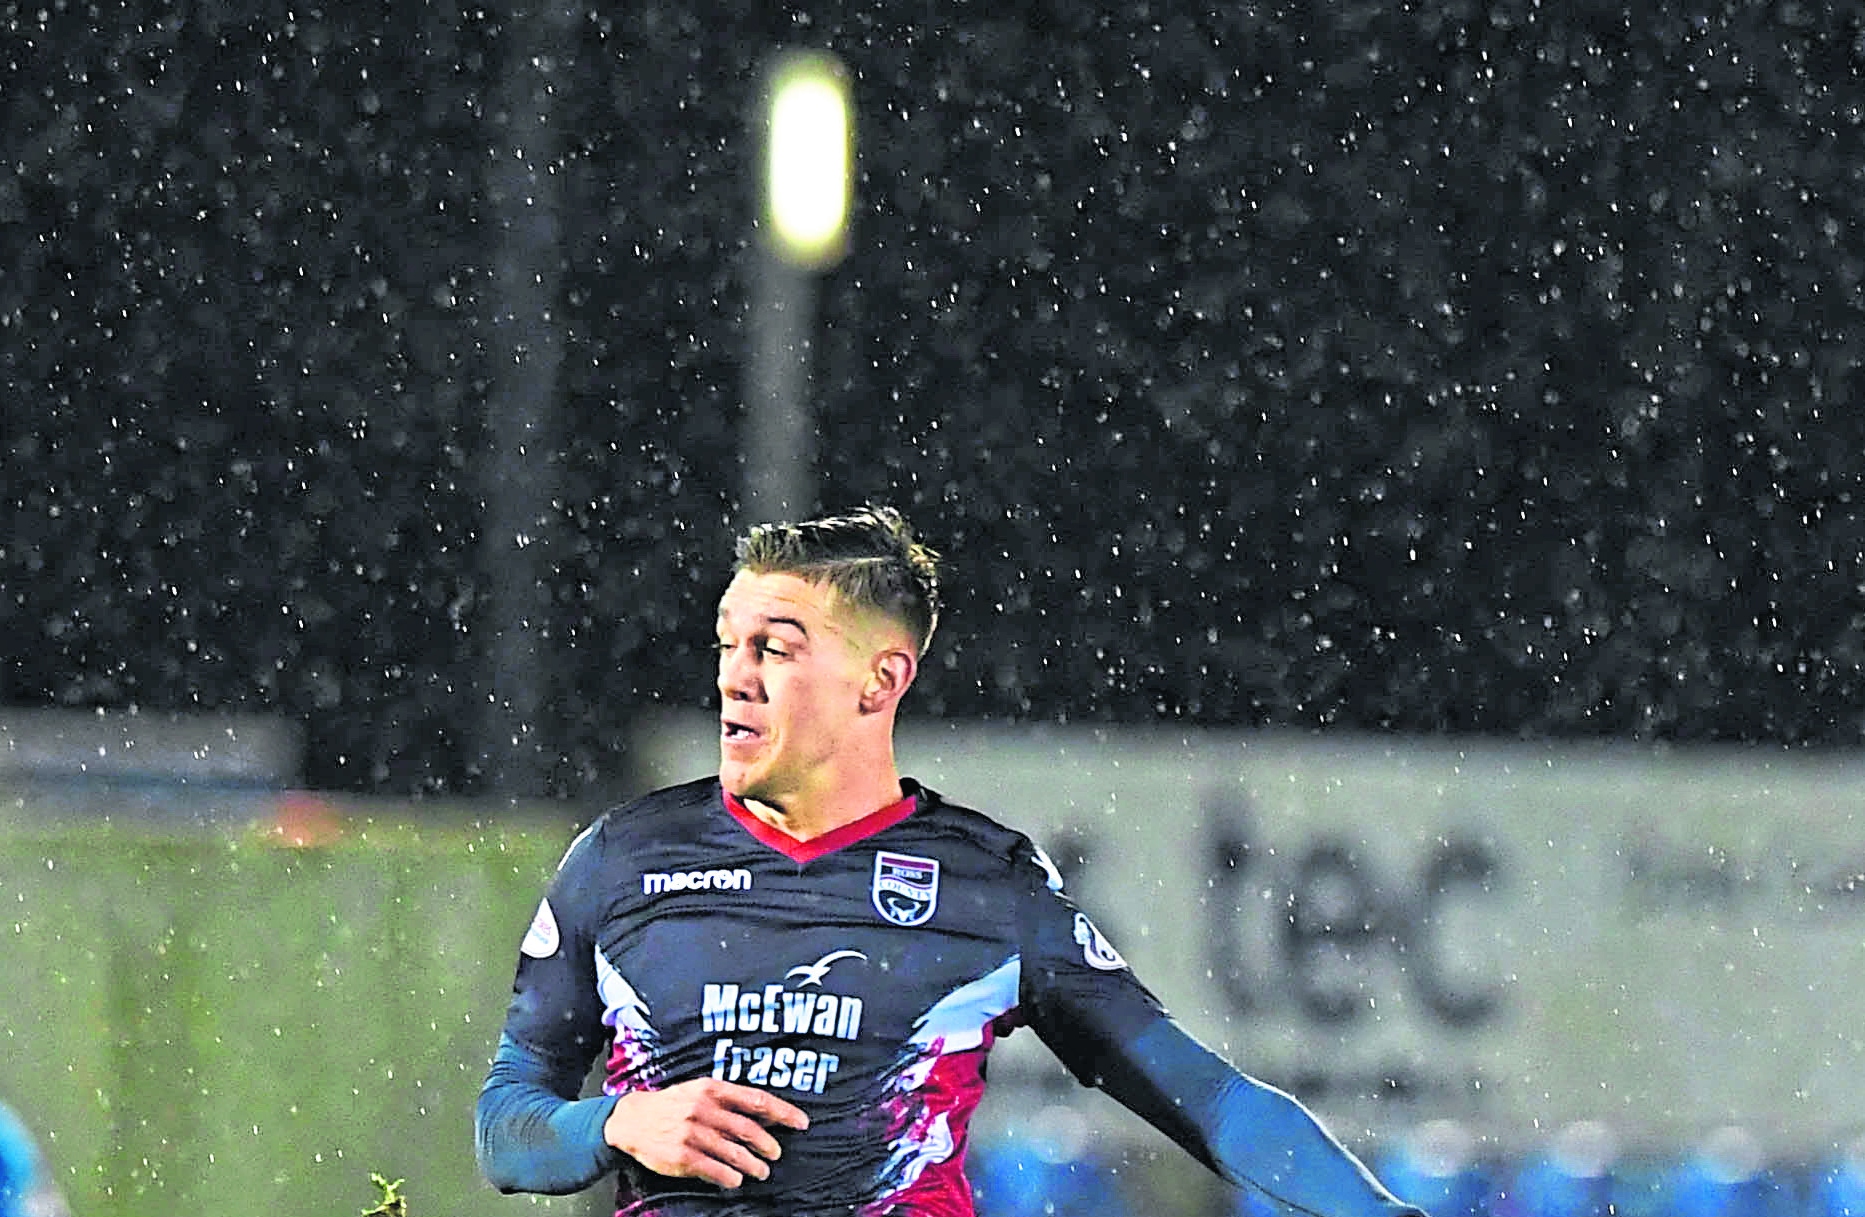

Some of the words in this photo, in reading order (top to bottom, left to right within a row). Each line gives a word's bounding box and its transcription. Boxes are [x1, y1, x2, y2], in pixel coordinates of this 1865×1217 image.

[643, 868, 752, 895] macron
[701, 983, 863, 1040] McEwan
[711, 1038, 840, 1094] Fraser
